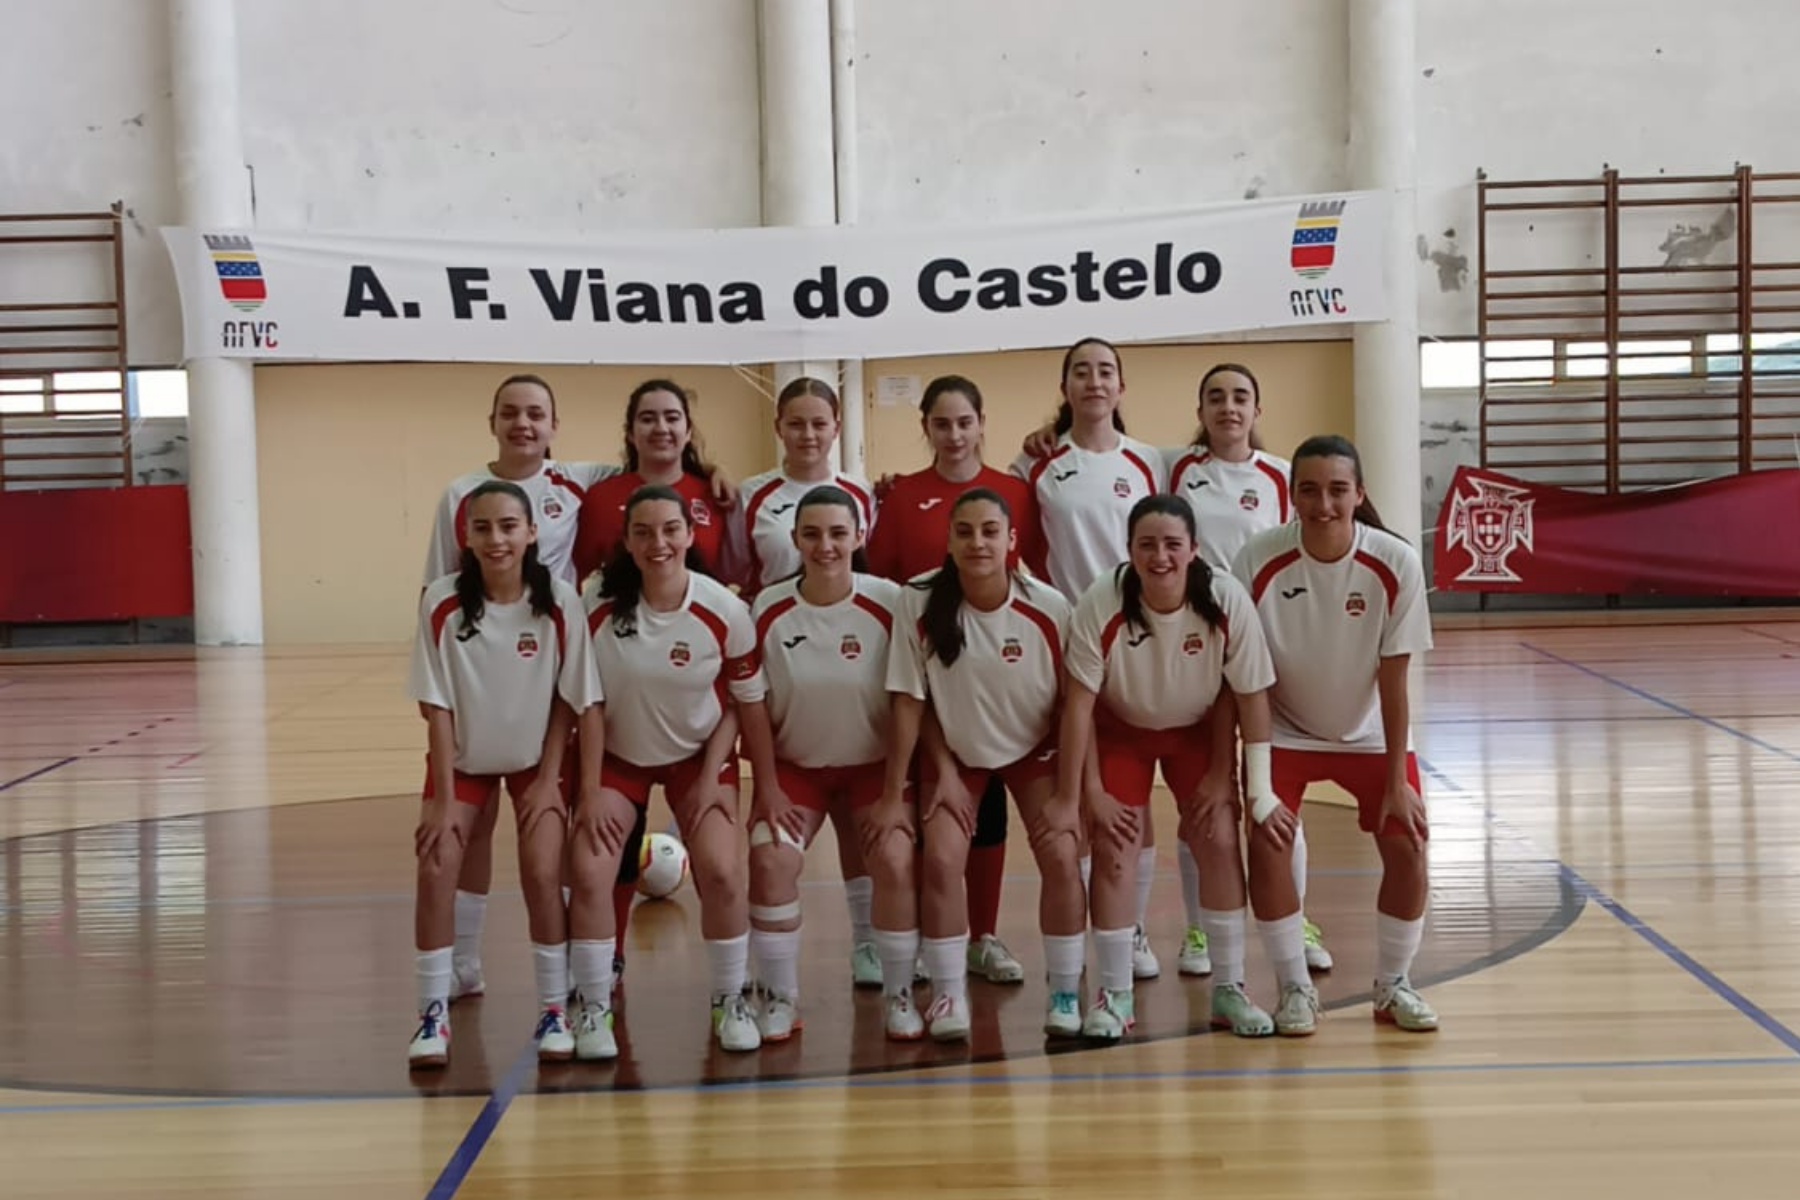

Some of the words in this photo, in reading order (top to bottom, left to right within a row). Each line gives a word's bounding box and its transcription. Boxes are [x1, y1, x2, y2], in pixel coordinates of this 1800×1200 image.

[343, 265, 421, 319] A.
[445, 266, 507, 321] F.
[528, 268, 766, 325] Viana
[793, 265, 890, 320] do
[917, 242, 1223, 313] Castelo
